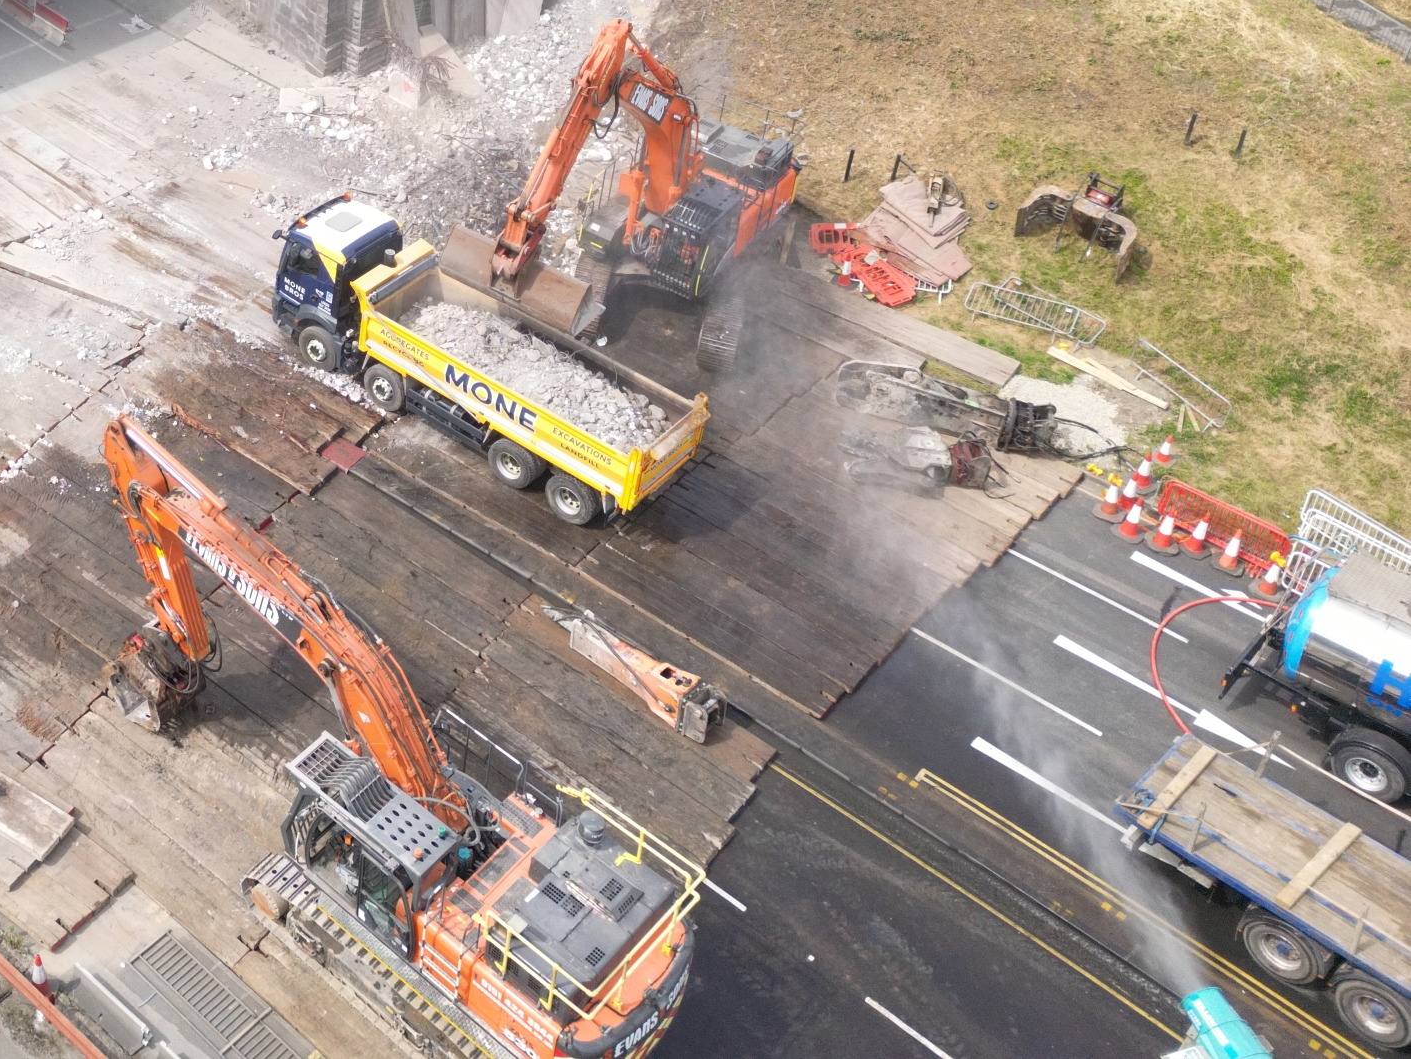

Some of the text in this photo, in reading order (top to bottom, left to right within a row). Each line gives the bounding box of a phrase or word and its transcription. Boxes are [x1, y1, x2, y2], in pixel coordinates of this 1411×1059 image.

[284, 277, 306, 294] MONE
[284, 284, 304, 301] BROS
[444, 363, 538, 433] MONE
[552, 427, 612, 466] EXCAVATIONS
[560, 443, 601, 470] LANDFILL
